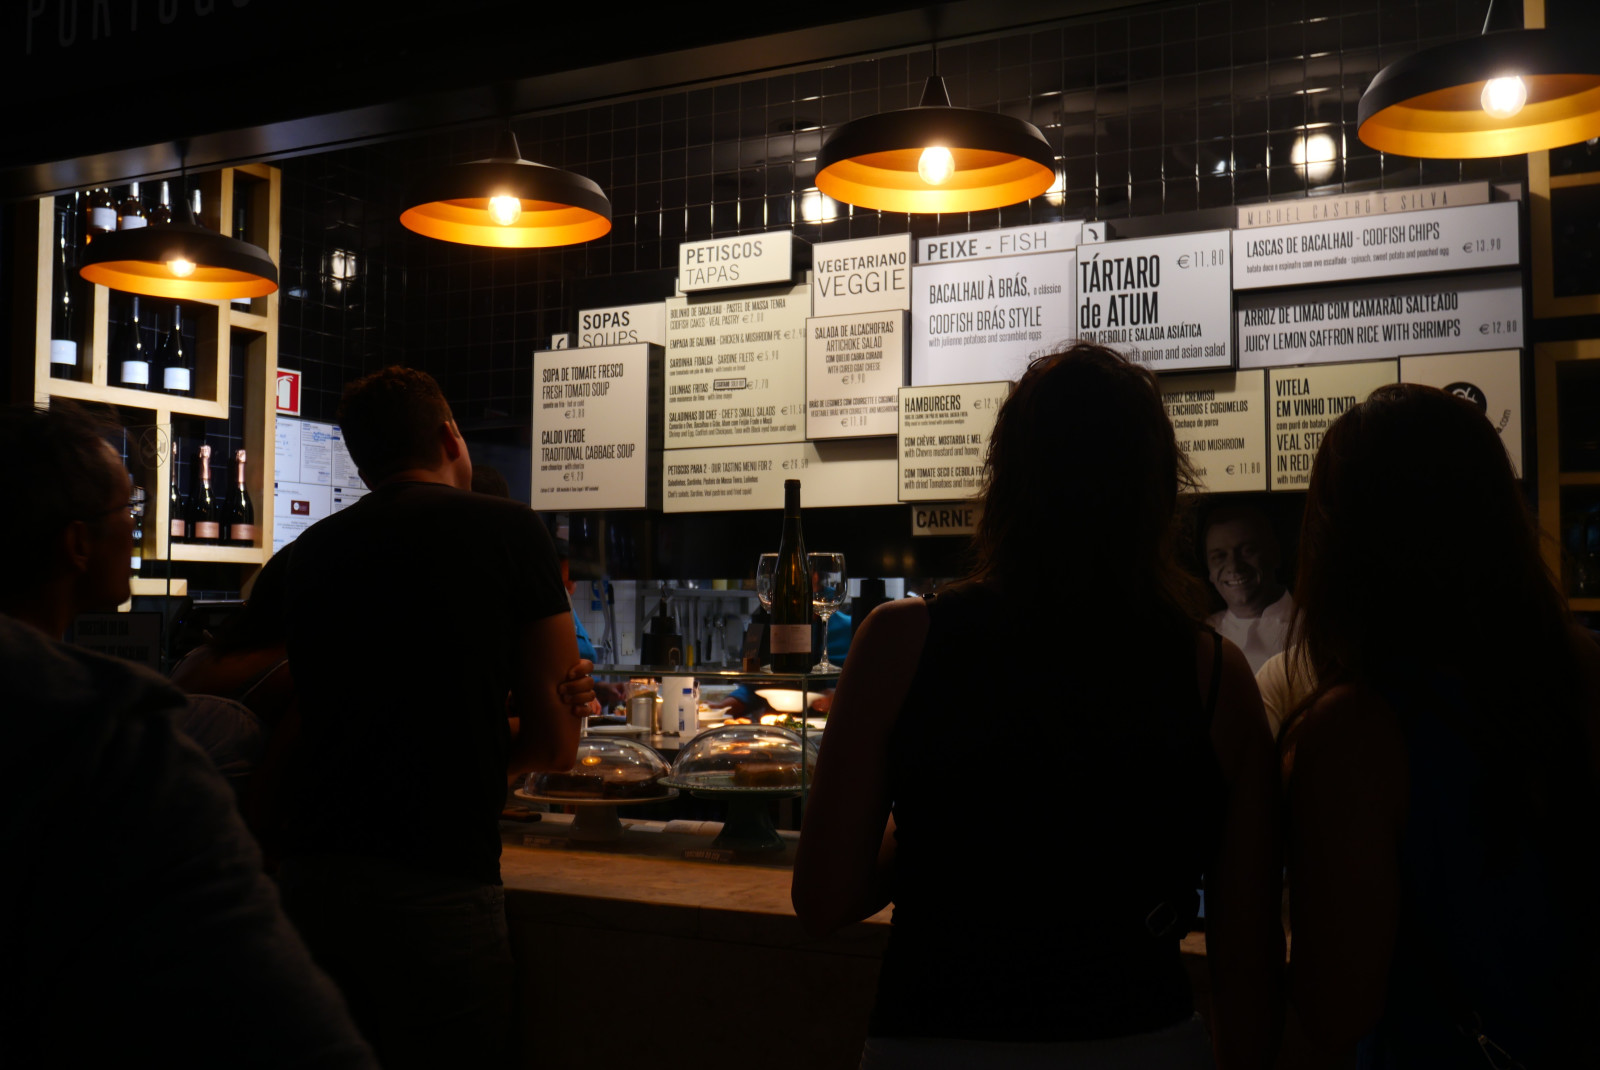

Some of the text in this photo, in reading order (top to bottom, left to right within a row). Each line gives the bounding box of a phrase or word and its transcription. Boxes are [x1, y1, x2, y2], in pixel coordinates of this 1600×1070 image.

[1248, 192, 1448, 225] MIGUEL CASTRO SILVA
[928, 230, 1048, 261] PEIXE FISH
[1247, 222, 1440, 258] LASCAS DE BACALHAU CODFISH CHIPS
[686, 240, 763, 265] PETISCOS
[1406, 250, 1416, 258] and
[817, 252, 907, 274] VEGETARIANO
[1080, 252, 1160, 293] TÁRTARO
[685, 264, 740, 286] TAPAS
[818, 268, 906, 298] VEGGIE
[929, 272, 1062, 304] BACALHAU À BRÁS, clássico
[1080, 291, 1158, 329] de ATUM
[1244, 292, 1458, 327] ARROZ DE LIMÃO COM CAMARÃO SALTEADO
[583, 310, 630, 330] SOPAS
[929, 305, 1042, 335] CODFISH BRÁS STYLE
[815, 321, 894, 339] SALADA DE ALCACHOFRAS
[928, 338, 940, 348] with
[964, 334, 986, 346] potatoes
[988, 334, 998, 342] and
[999, 331, 1028, 342] scrambled
[1129, 328, 1132, 342] E
[1135, 326, 1164, 342] SALADA
[1167, 321, 1202, 340] ASIÁTICA
[1244, 318, 1460, 352] JUICY LEMON SAFFRON RICE WITH SHRIMPS
[826, 336, 882, 352] ARTICHOKE SALAD
[1165, 346, 1180, 360] and
[1182, 344, 1203, 358] asian
[1204, 342, 1226, 358] salad
[543, 363, 624, 383] SOPA DE TOMATE FRESCO
[828, 365, 838, 374] WITH
[542, 381, 610, 400] FRESH TOMATO SOUP
[1184, 390, 1215, 403] CREMOSO
[1276, 378, 1310, 397] VITELA
[904, 394, 961, 413] HAMBURGERS
[1172, 400, 1248, 416] ENCHIDOS E COGUMELOS
[1276, 400, 1290, 418] EM
[1294, 398, 1324, 416] VINHO
[1276, 422, 1287, 430] com
[1302, 420, 1308, 430] de
[1309, 419, 1327, 429] batata
[541, 428, 586, 445] CALDO VERDE
[904, 434, 982, 447] COM MOSTARDA E MEL
[1193, 437, 1245, 452] AND MUSHROOM
[1277, 433, 1301, 451] VEAL
[541, 443, 635, 462] TRADITIONAL CABBAGE SOUP
[904, 449, 915, 458] with
[904, 469, 915, 478] COM
[954, 466, 975, 477] CEBOLA
[1277, 455, 1287, 472] IN
[1290, 454, 1309, 472] RED
[904, 480, 915, 490] with
[1277, 475, 1288, 484] with
[916, 510, 974, 528] CARNE
